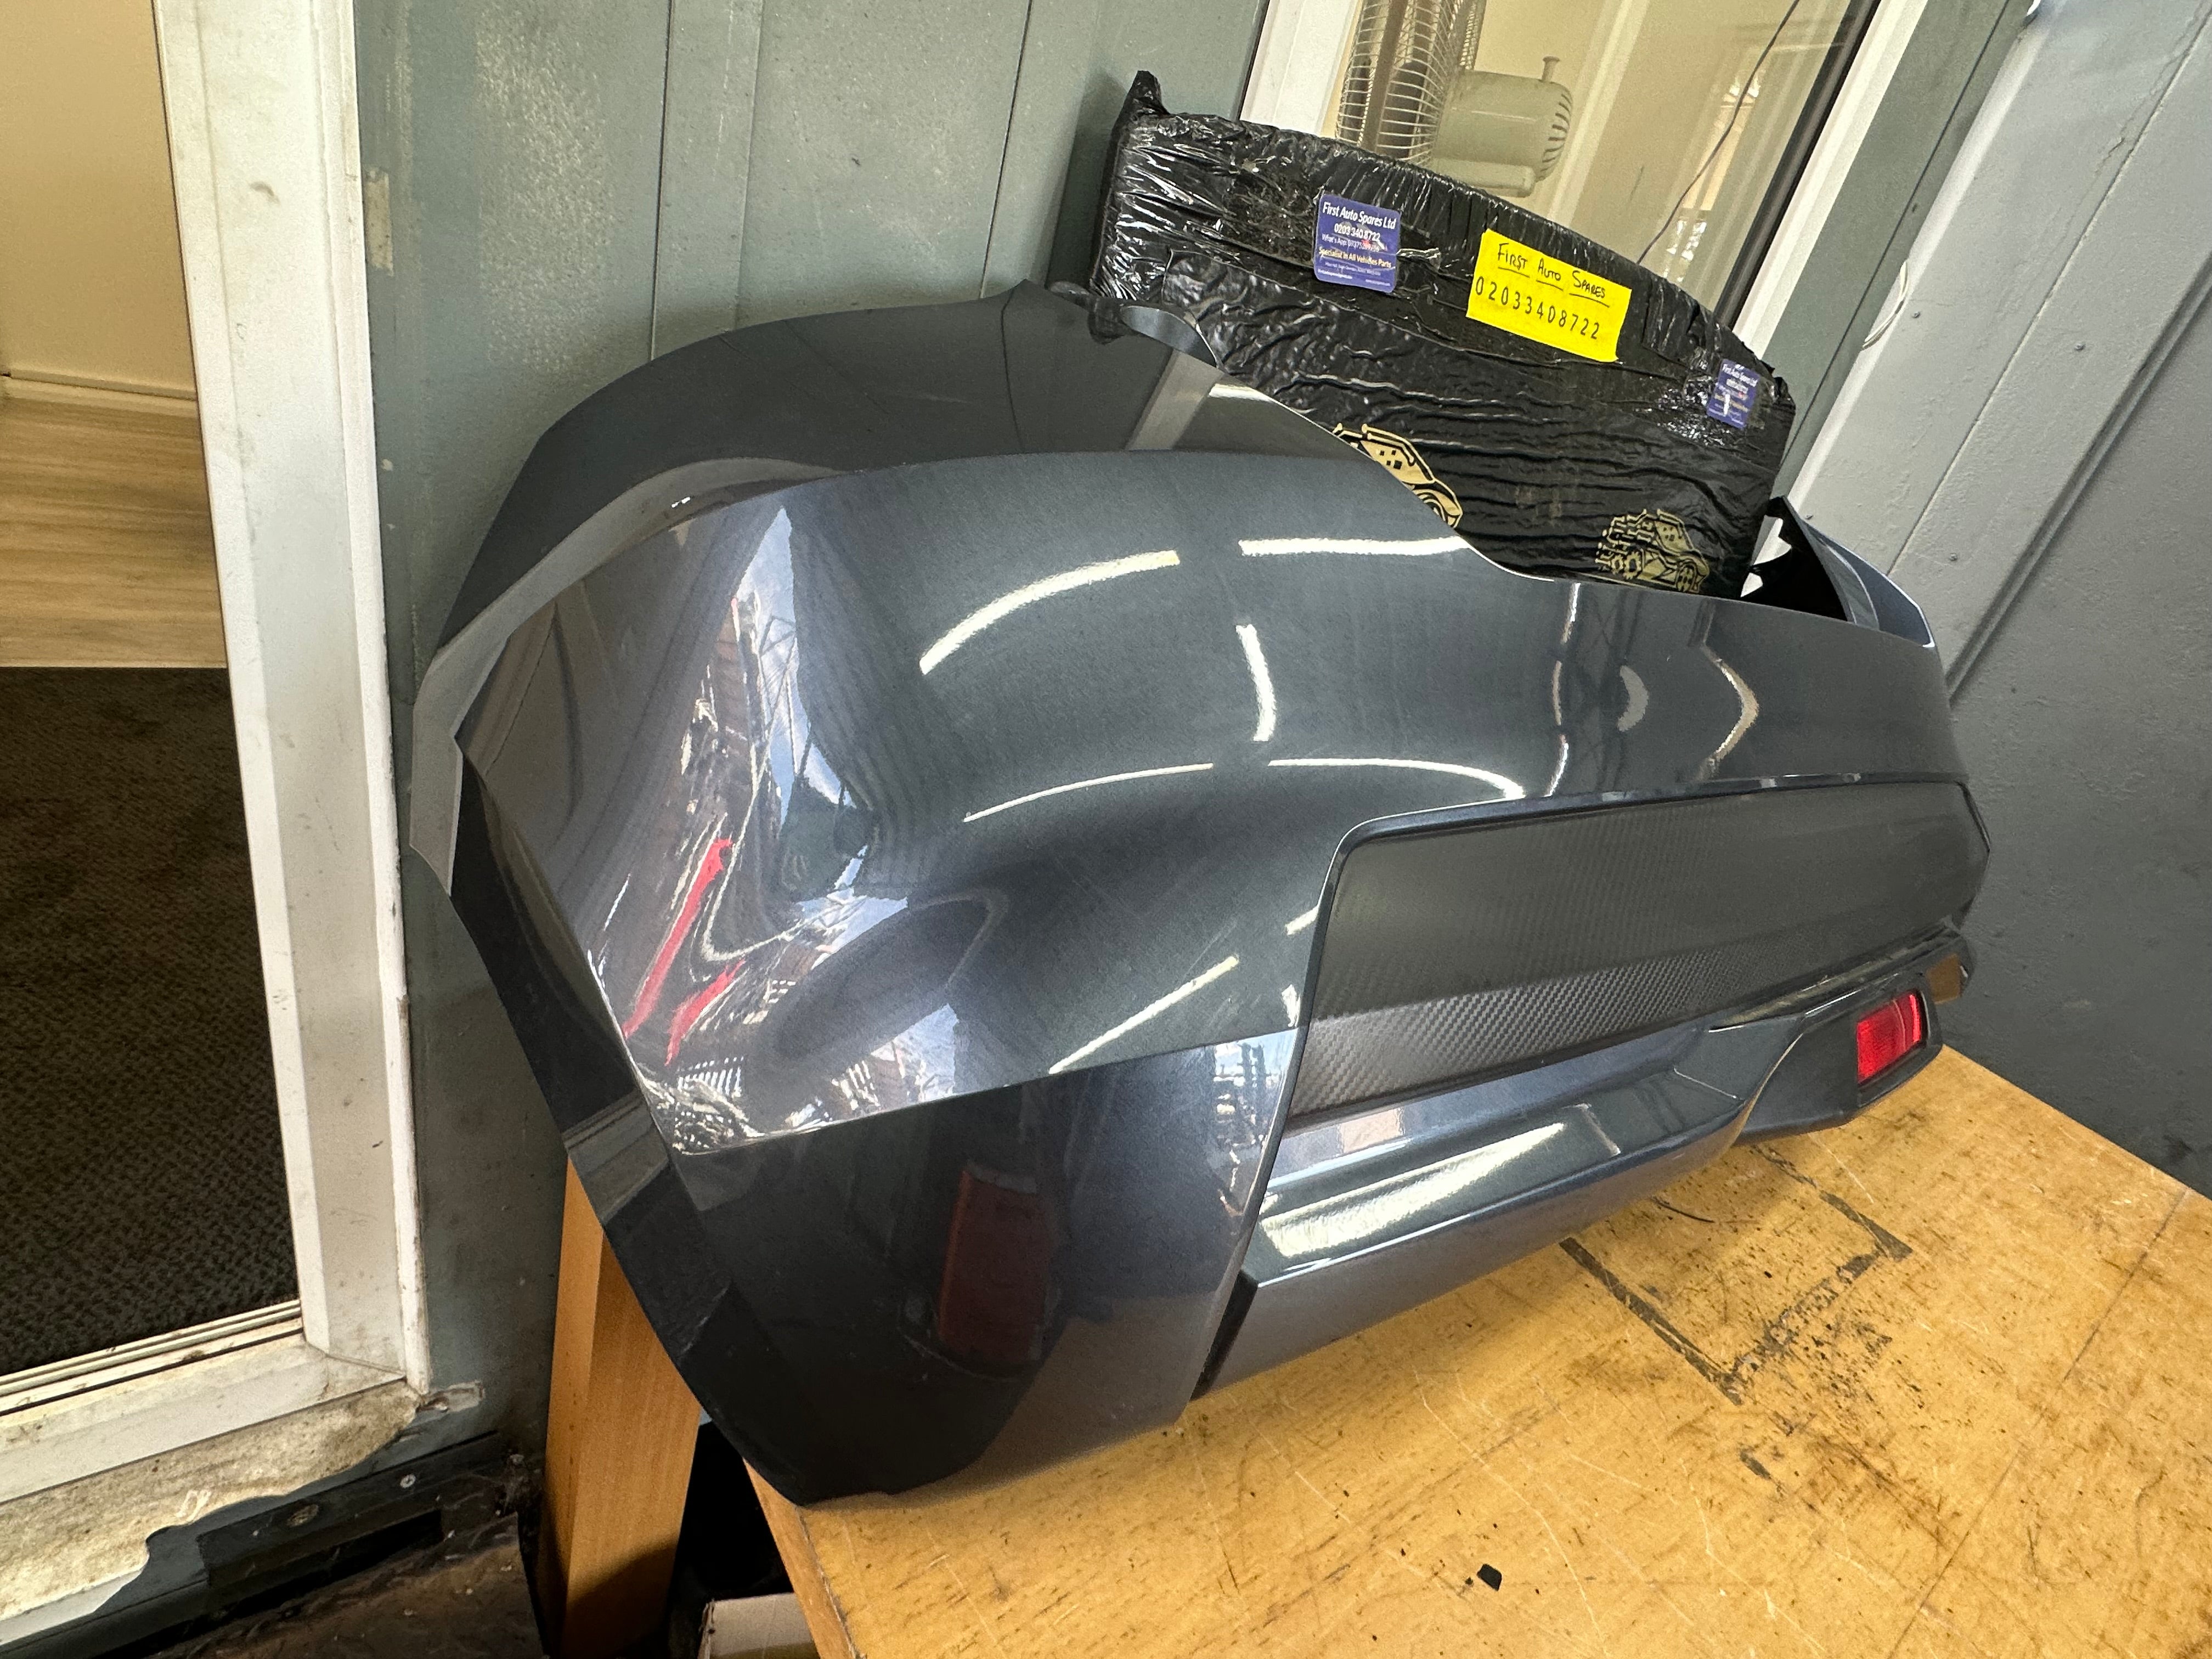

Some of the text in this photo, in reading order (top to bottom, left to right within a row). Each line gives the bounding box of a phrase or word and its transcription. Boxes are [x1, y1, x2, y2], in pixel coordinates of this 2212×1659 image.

[1322, 201, 1397, 230] First Auto Spares Ltd
[1334, 223, 1381, 242] 0203 340 8722
[1378, 258, 1392, 268] Parts
[1537, 257, 1561, 281] AUTO
[1571, 270, 1606, 299] SPARES
